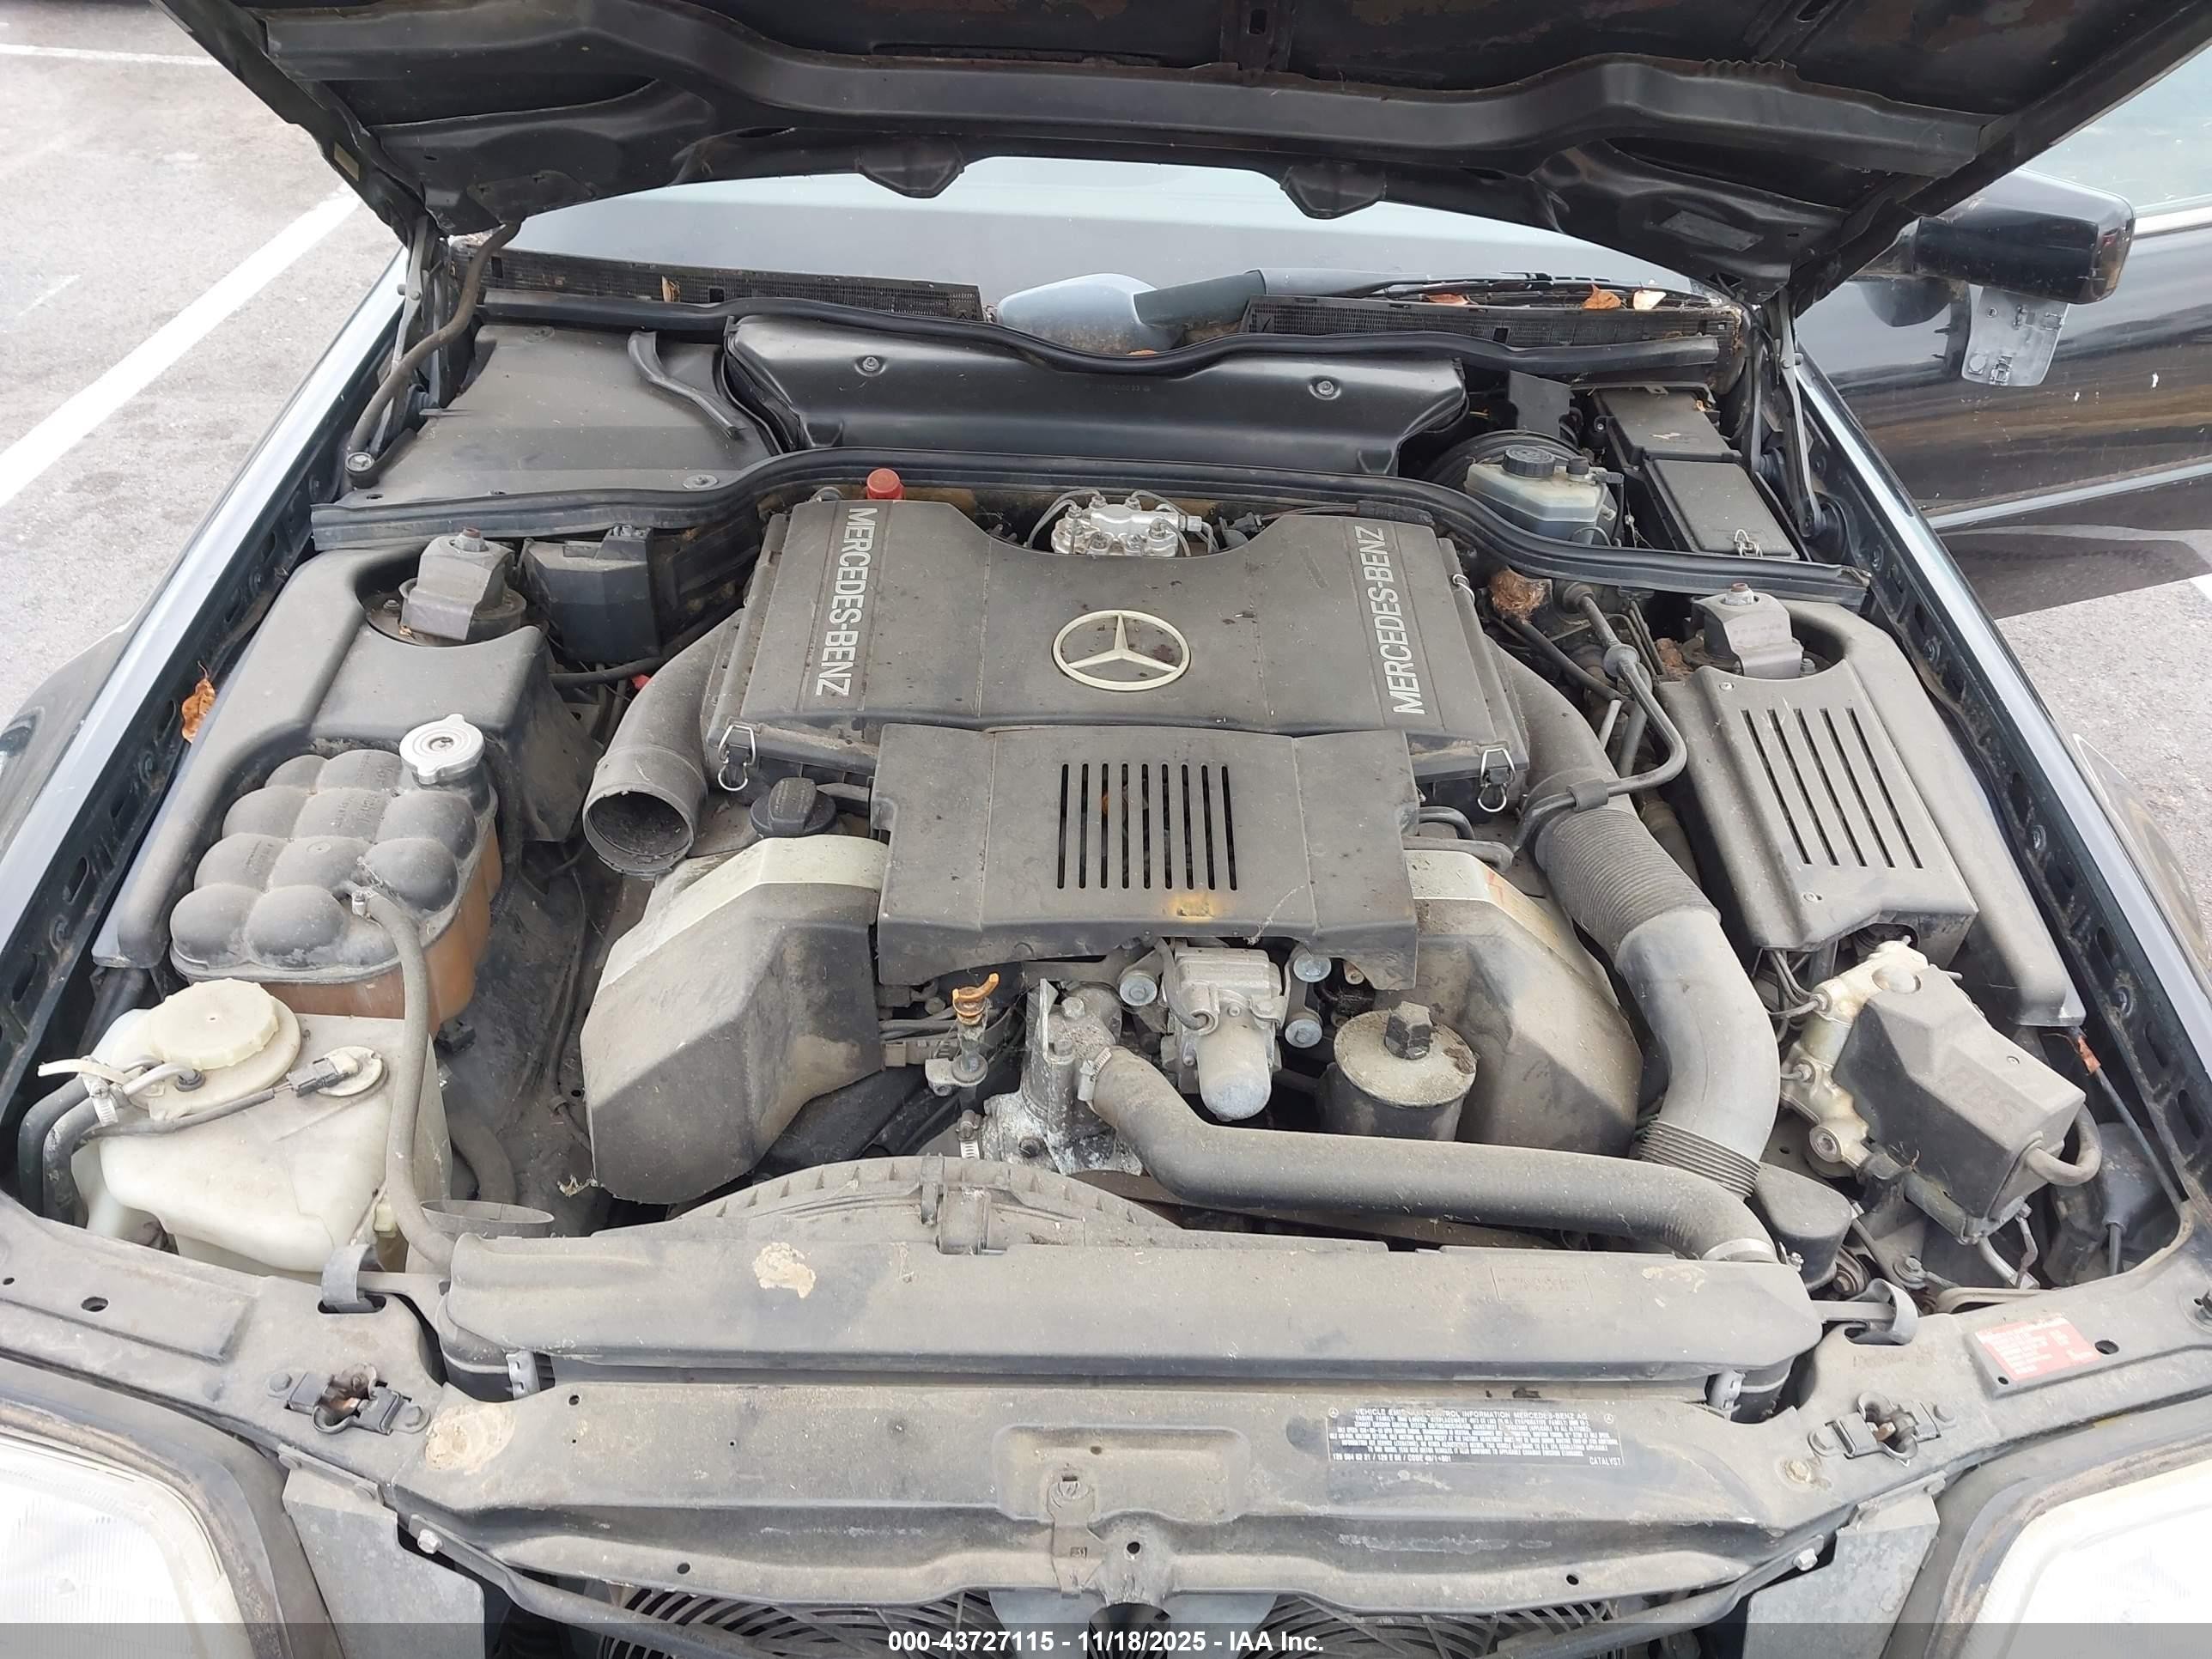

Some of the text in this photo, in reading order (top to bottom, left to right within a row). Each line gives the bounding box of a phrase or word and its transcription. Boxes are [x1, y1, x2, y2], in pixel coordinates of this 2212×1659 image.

[816, 507, 878, 696] MERCEDES-BENZ
[1354, 526, 1425, 714] MERCEDES-BENZ
[1355, 1407, 1386, 1416] VEHICLE
[1462, 1410, 1510, 1419] INFORMATION
[1514, 1411, 1574, 1419] MERCEDES-BENZ
[1589, 1455, 1621, 1466] CATALYST
